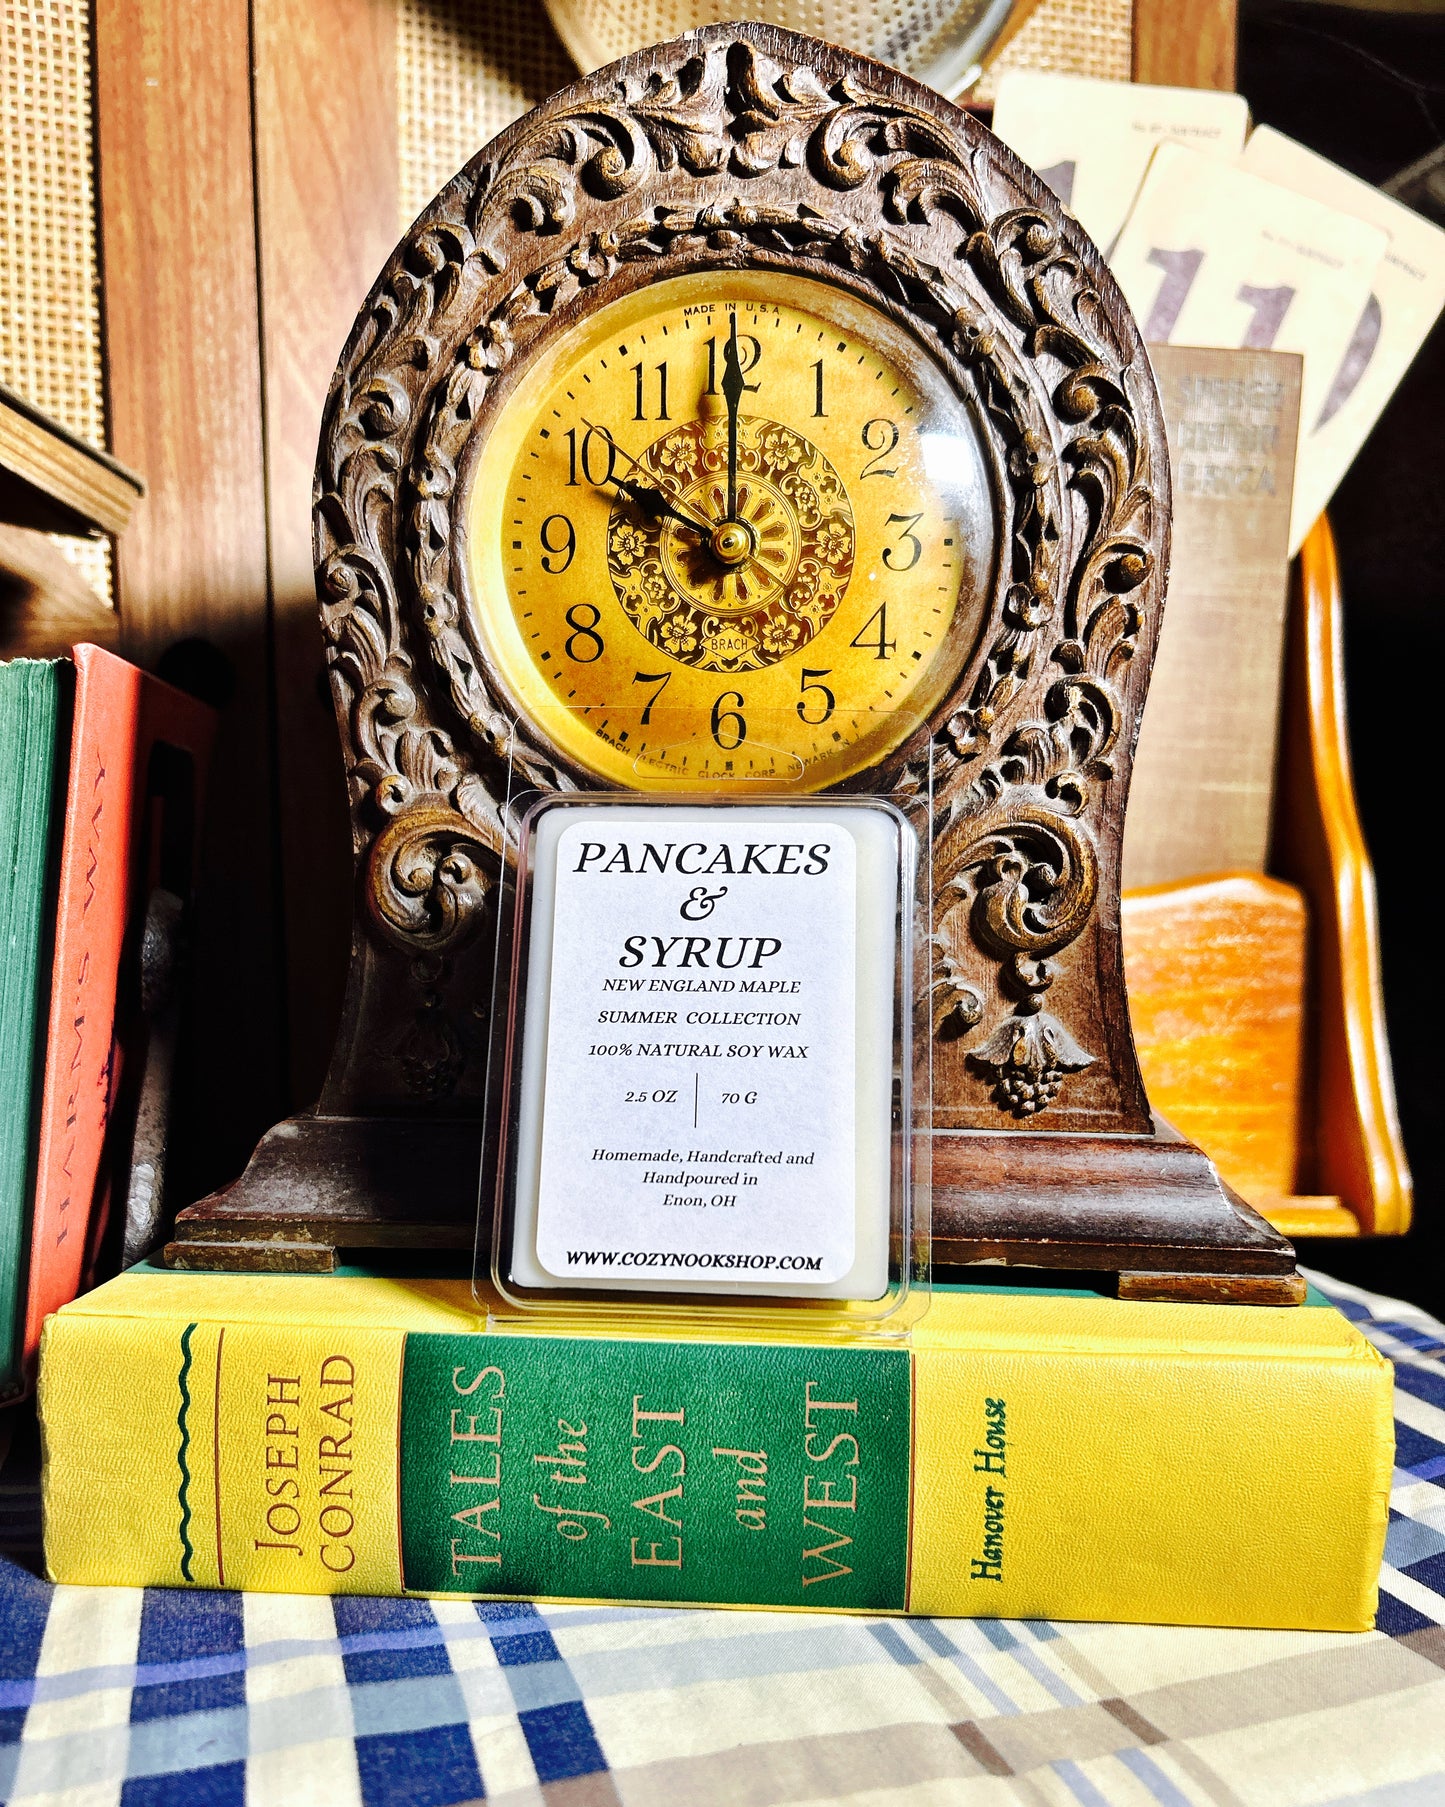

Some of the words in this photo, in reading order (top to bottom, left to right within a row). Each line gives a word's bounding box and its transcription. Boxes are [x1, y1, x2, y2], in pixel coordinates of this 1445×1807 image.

[684, 303, 716, 317] MADE
[725, 302, 737, 311] IN
[632, 361, 673, 421] 11
[703, 335, 762, 396] 12
[810, 359, 830, 418] 1
[564, 426, 616, 487] 10
[860, 418, 900, 480] 2
[541, 515, 577, 574] 9
[882, 513, 923, 572] 3
[564, 603, 605, 663] 8
[711, 638, 748, 651] BRACH
[850, 601, 897, 661] 4
[632, 672, 672, 725] 7
[710, 691, 747, 750] 6
[797, 668, 837, 725] 5
[595, 728, 631, 755] BRACH
[698, 770, 735, 780] CLOCK
[80, 744, 106, 920] WAY
[572, 842, 831, 876] PANCAKES
[679, 885, 728, 922] &
[618, 935, 782, 969] SYRUP
[602, 978, 647, 993] NEW
[648, 979, 736, 994] ENGLAND
[739, 980, 802, 995] MAPLE
[597, 1010, 678, 1025] SUMMER
[686, 1011, 802, 1026] COLLECTION
[588, 1043, 633, 1057] 100%
[636, 1043, 723, 1058] NATURAL
[726, 1044, 765, 1059] SOY
[767, 1045, 809, 1060] WAX
[624, 1090, 648, 1104] 2.5
[652, 1089, 678, 1104] OZ
[721, 1092, 740, 1106] 70
[744, 1091, 758, 1105] G
[592, 1147, 684, 1164] Homemade,
[686, 1149, 783, 1165] Handcrafted
[785, 1150, 815, 1166] and
[642, 1170, 740, 1188] Handpoured
[743, 1171, 759, 1186] in
[662, 1193, 708, 1210] Enon,
[710, 1194, 738, 1209] OH
[566, 1250, 824, 1272] WWW.COZYNOOKSHOP.COM
[254, 1373, 303, 1556] JOSEPH
[319, 1355, 355, 1572] CONRAD
[534, 1419, 588, 1484] the
[973, 1397, 1007, 1478] House
[450, 1366, 505, 1576] TALES
[631, 1395, 686, 1570] EAST
[712, 1447, 768, 1530] and
[802, 1381, 859, 1588] WEST
[534, 1493, 611, 1541] of
[970, 1486, 1005, 1583] Hanover
